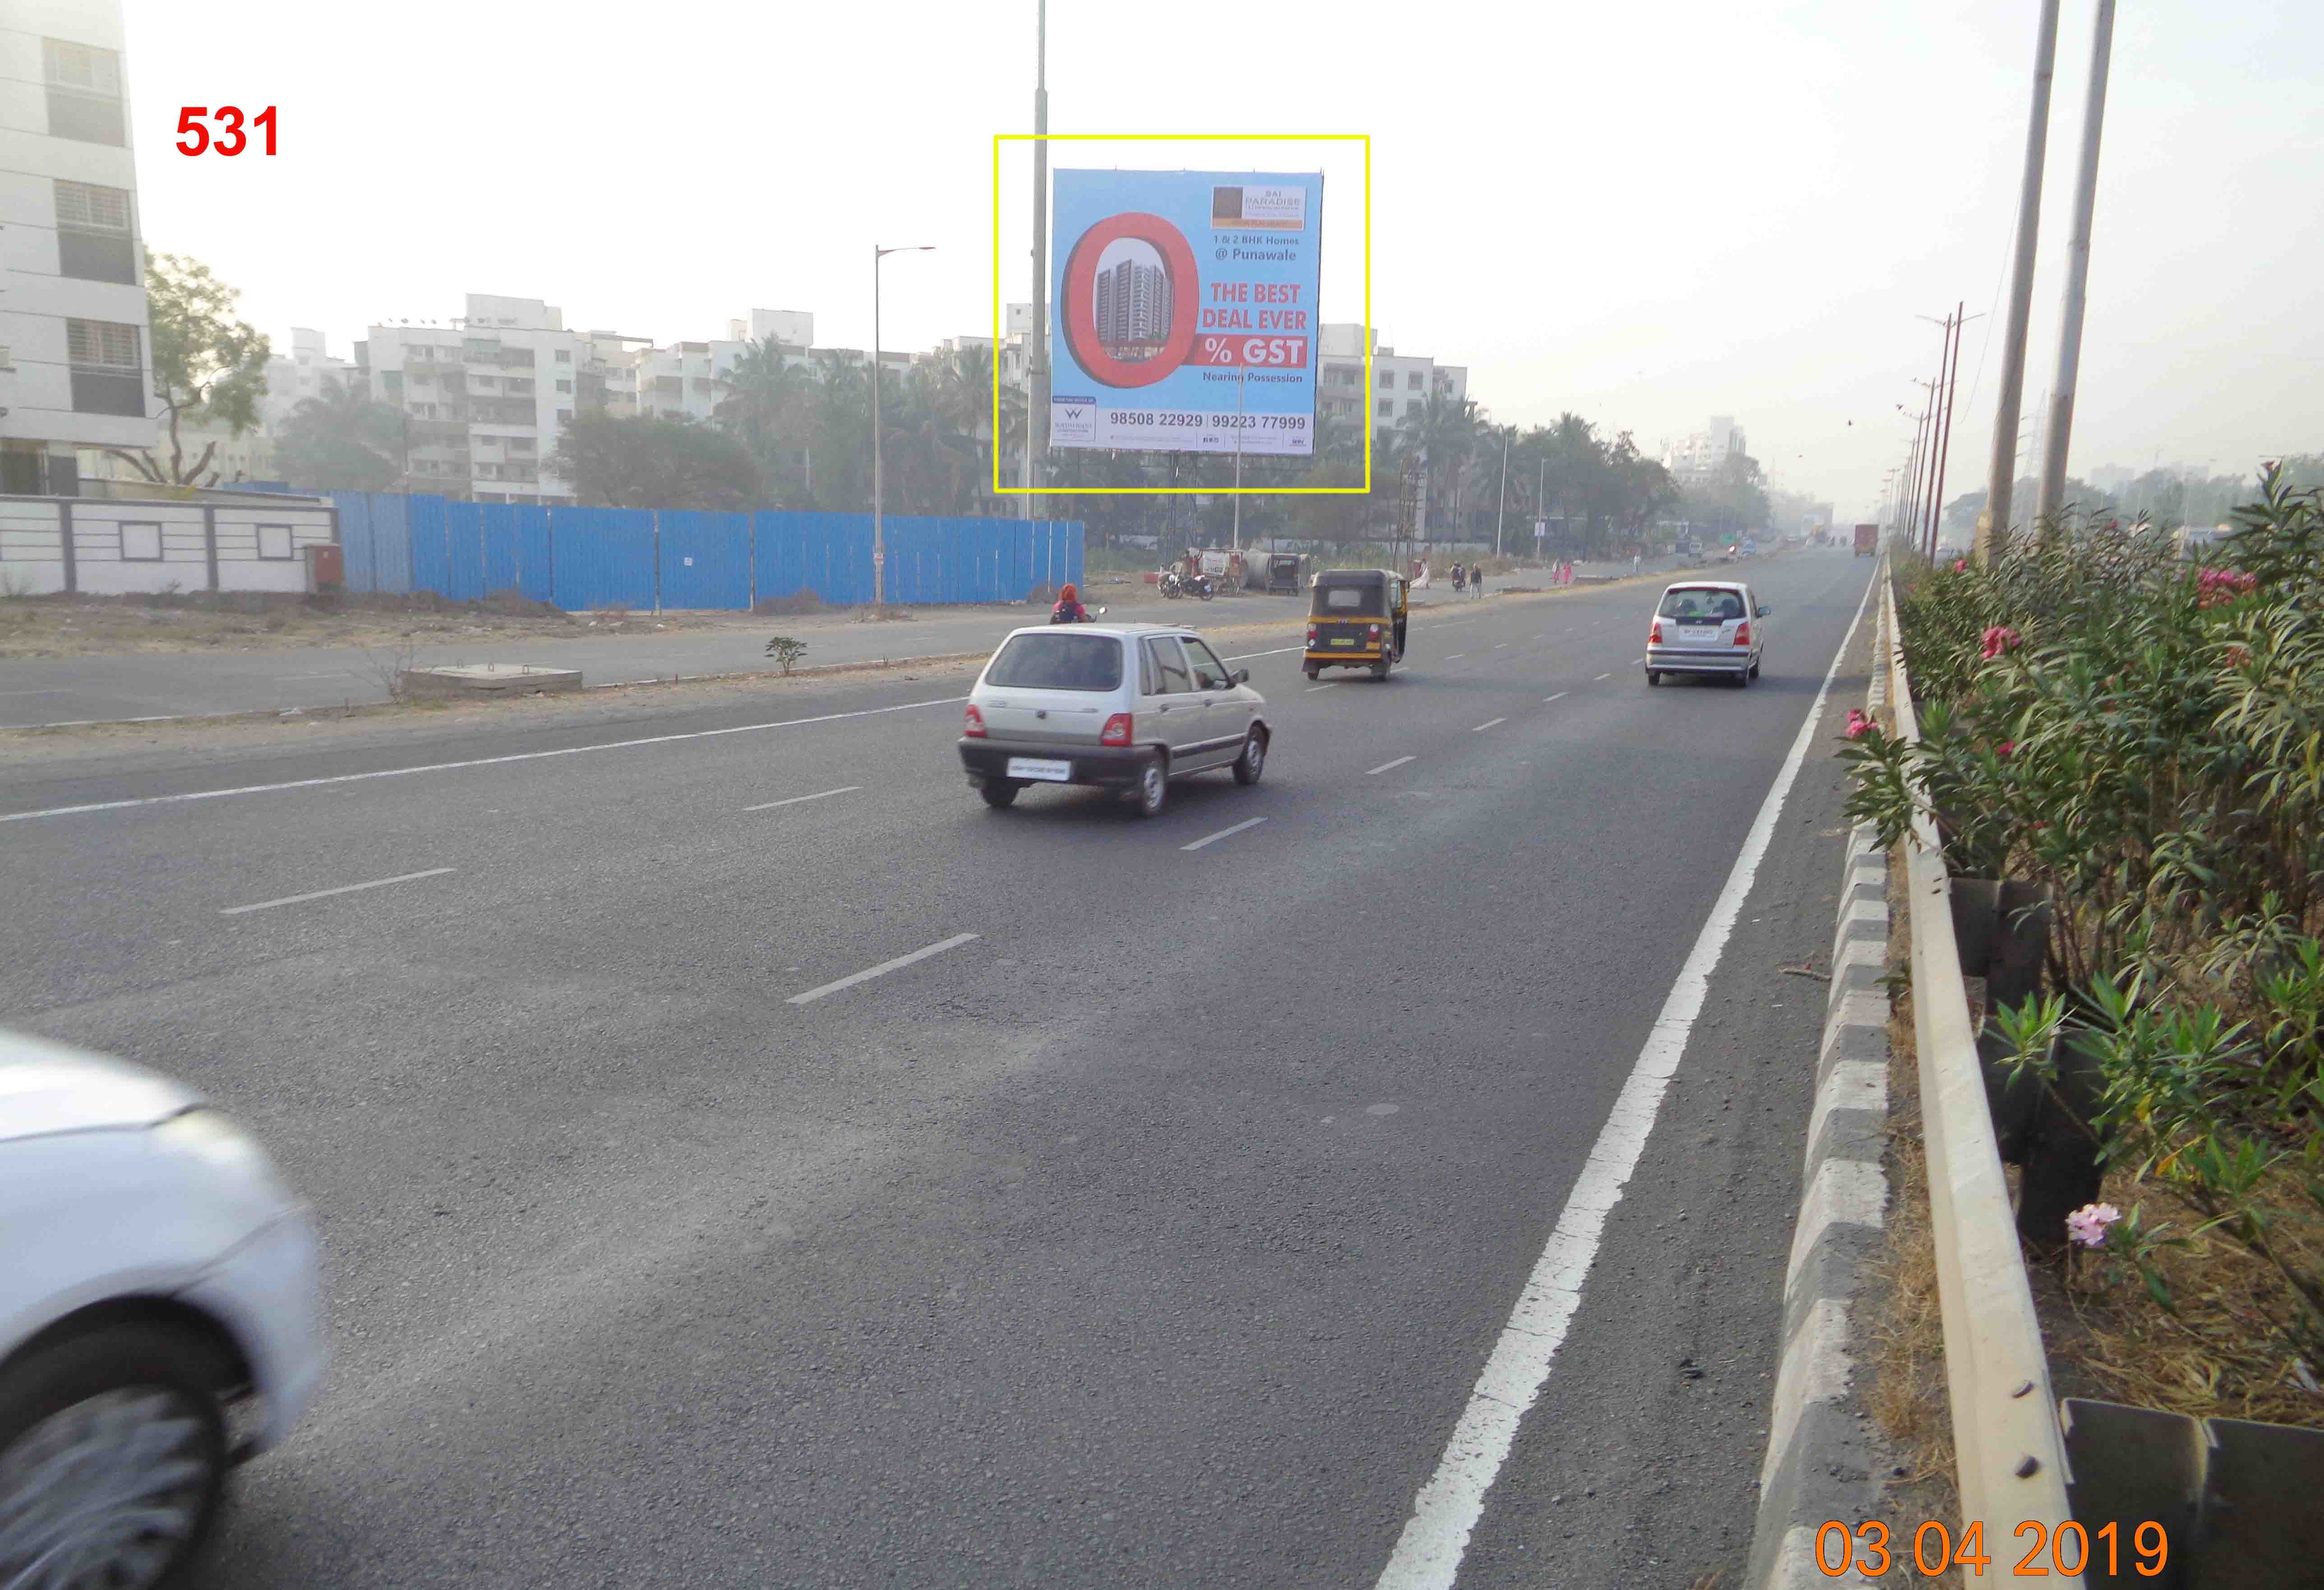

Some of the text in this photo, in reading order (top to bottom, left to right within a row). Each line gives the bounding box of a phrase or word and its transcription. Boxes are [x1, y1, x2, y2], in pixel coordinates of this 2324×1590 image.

[1214, 235, 1300, 245] 1 & 2 BHK Homes
[1215, 248, 1296, 261] @ Punawale
[1211, 282, 1301, 304] THE BEST
[1202, 309, 1307, 330] DEAL EVER
[1205, 337, 1303, 364] % GST
[1248, 373, 1303, 383] Possession
[1111, 412, 1305, 429] 98508 22929 99223 77999
